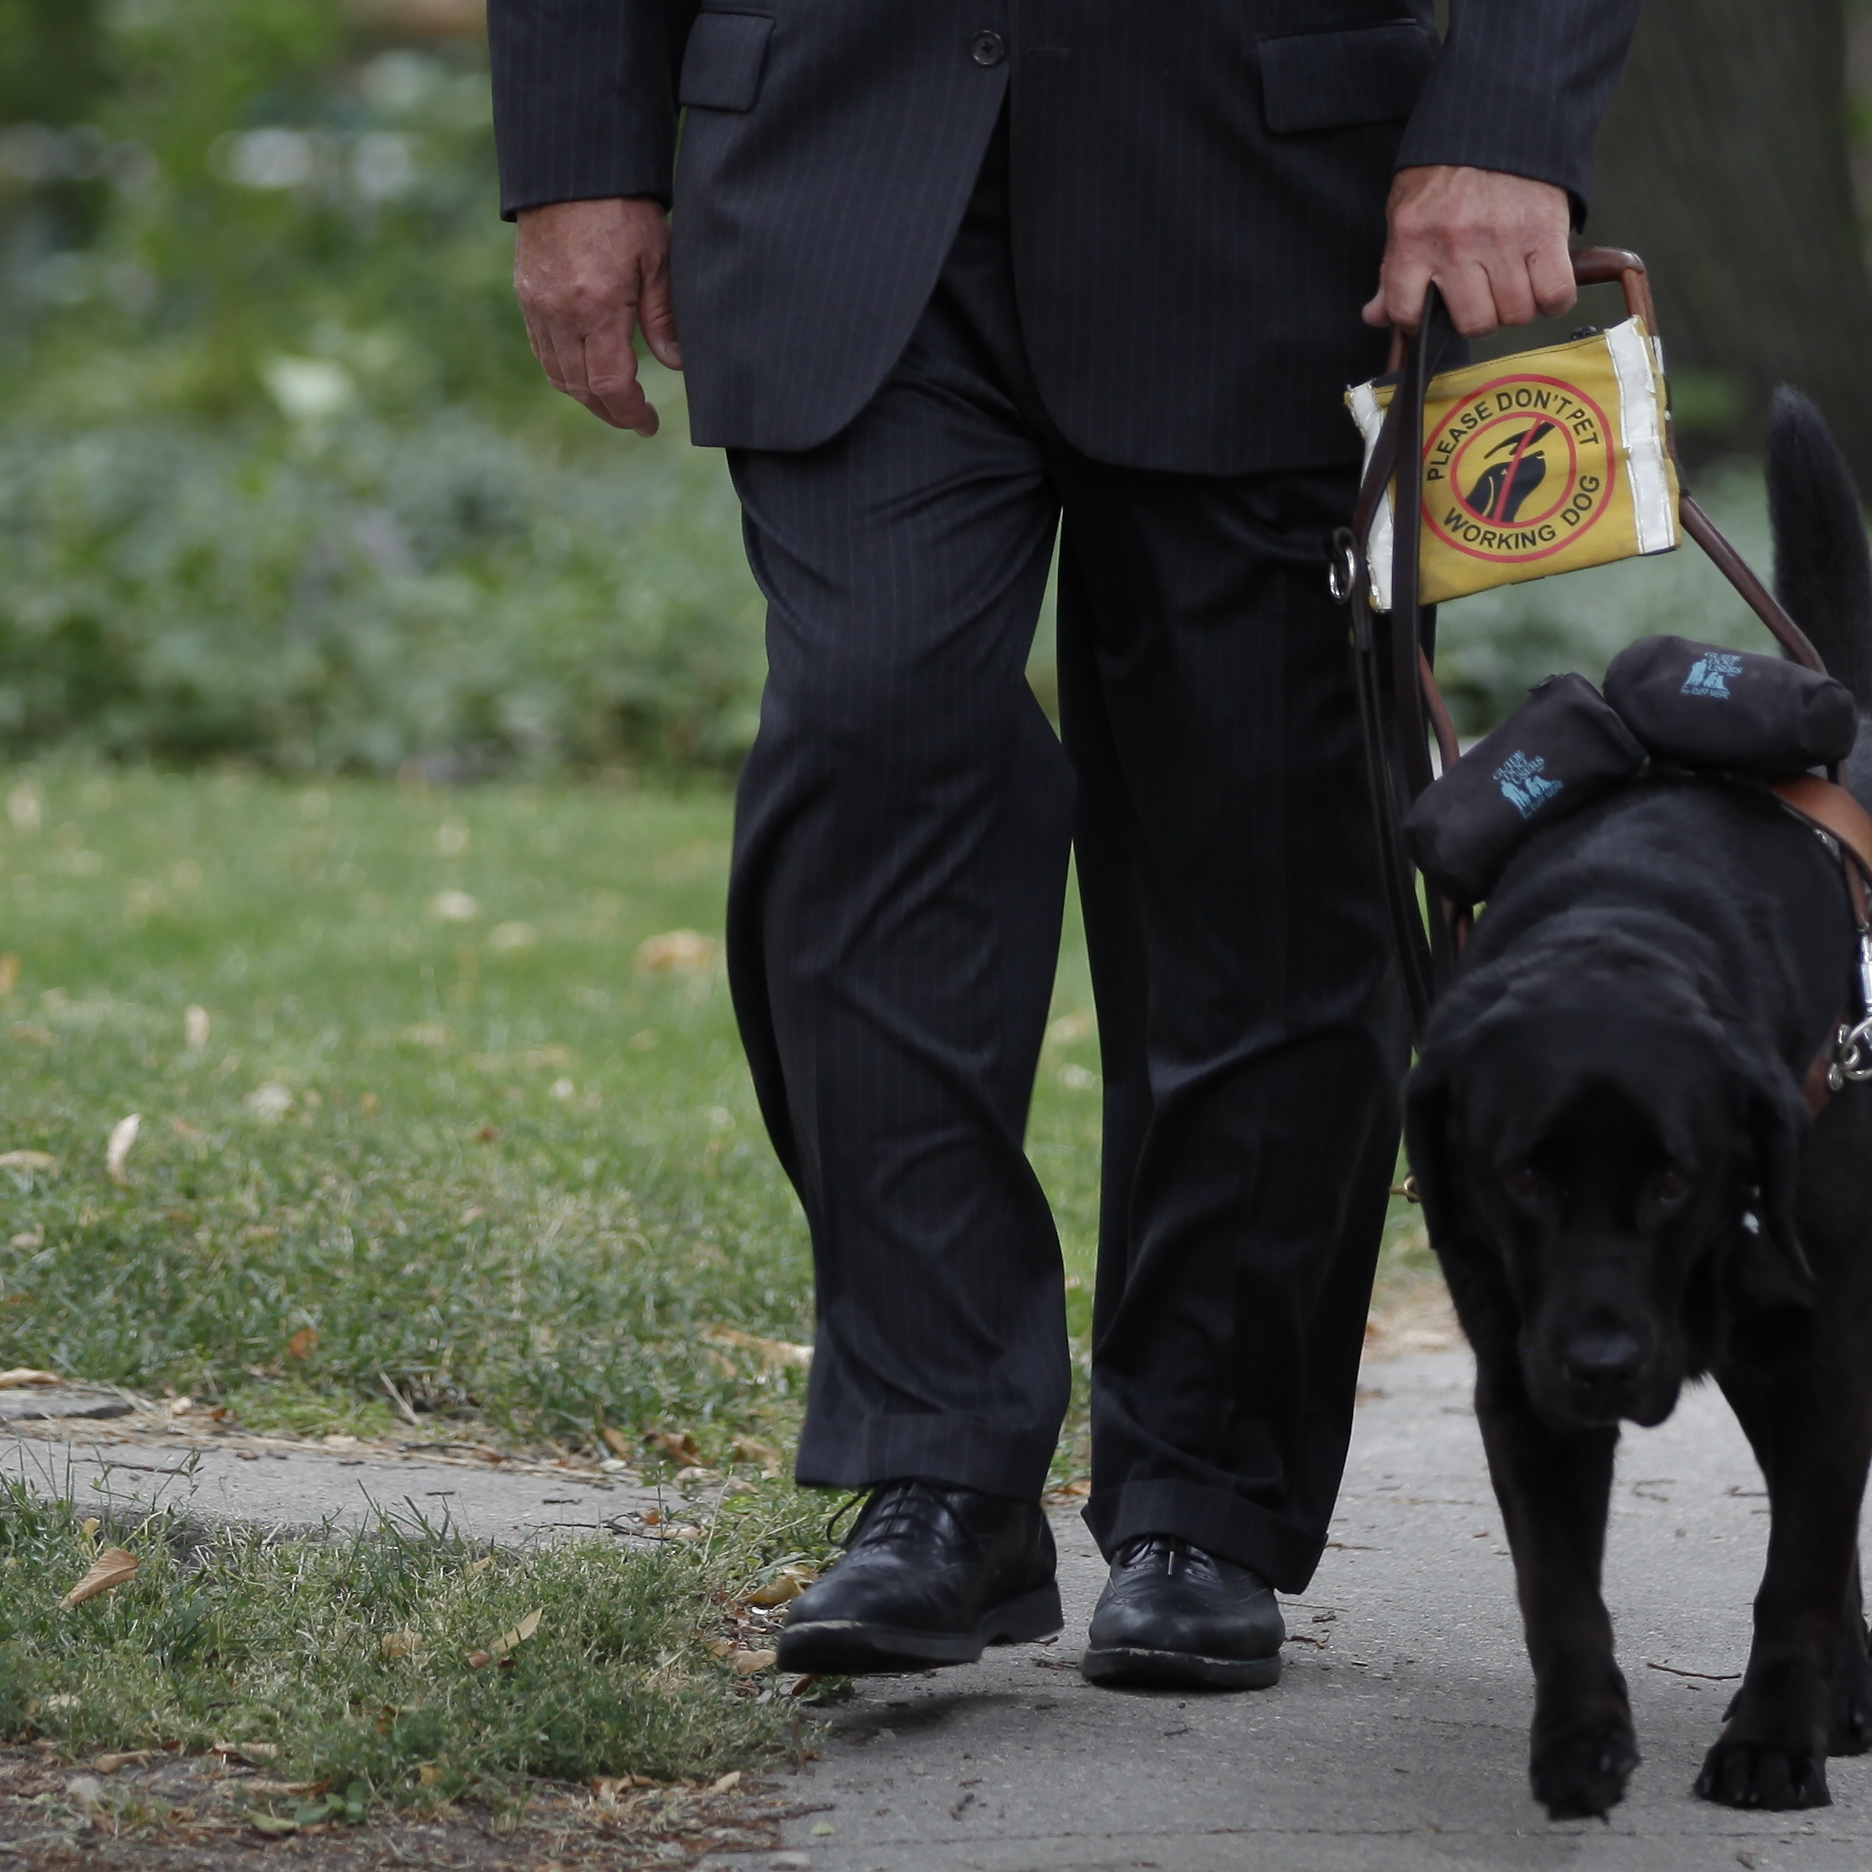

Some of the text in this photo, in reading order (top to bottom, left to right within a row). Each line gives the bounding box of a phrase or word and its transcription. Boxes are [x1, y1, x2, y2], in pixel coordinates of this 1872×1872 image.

[1427, 388, 1599, 481] PLEASE DON'T PET
[1443, 475, 1600, 550] WORKING DOG
